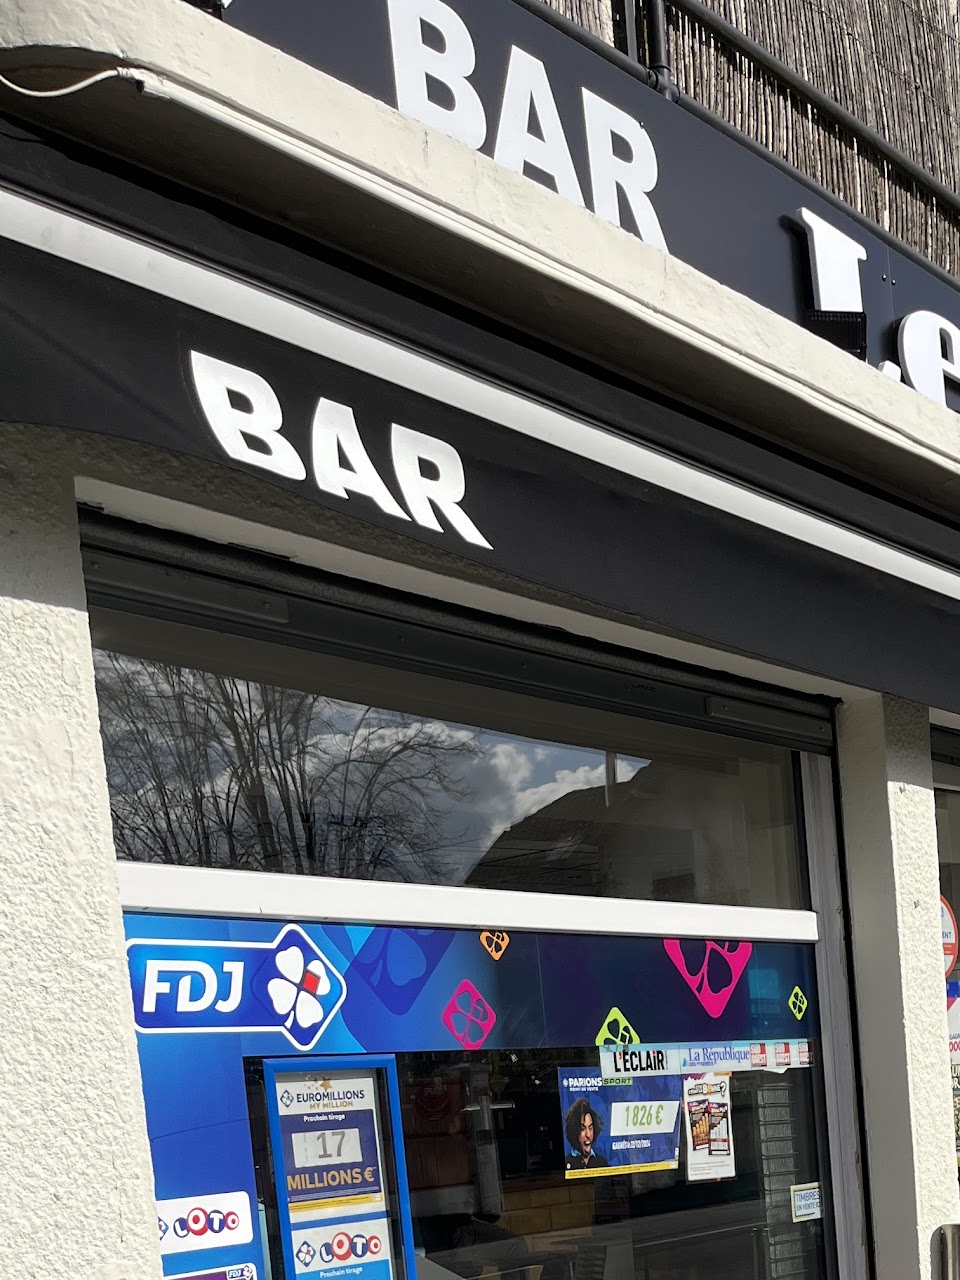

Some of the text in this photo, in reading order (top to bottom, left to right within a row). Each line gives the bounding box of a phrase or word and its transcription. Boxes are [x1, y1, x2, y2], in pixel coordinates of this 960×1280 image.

[388, 0, 670, 254] BAR
[190, 350, 494, 550] BAR
[143, 959, 245, 1013] FDJ
[688, 1047, 700, 1062] La
[702, 1046, 750, 1064] République
[568, 1077, 632, 1087] PARIONS SPORT
[296, 1089, 365, 1103] EUROMILLIONS
[309, 1100, 354, 1110] MY MILLION
[303, 1113, 346, 1123] Prochain tirage
[316, 1130, 346, 1159] 17
[287, 1168, 362, 1191] MILLIONS
[173, 1207, 240, 1239] LOTO
[320, 1231, 382, 1264] LOTO
[319, 1266, 363, 1279] Prochain tirage
